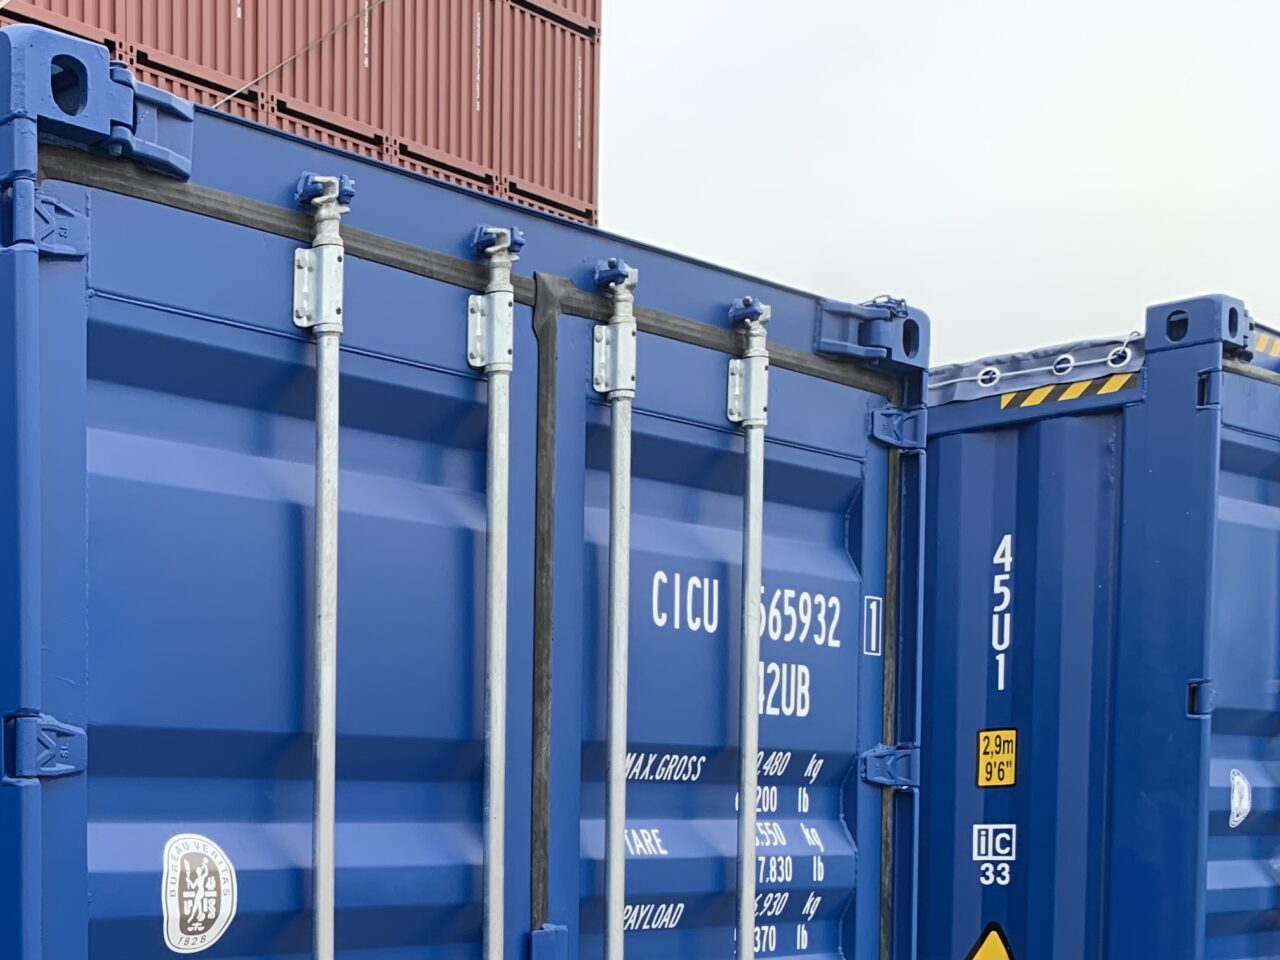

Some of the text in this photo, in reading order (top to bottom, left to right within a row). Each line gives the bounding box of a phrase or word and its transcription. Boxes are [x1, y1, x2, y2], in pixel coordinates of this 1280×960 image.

[652, 570, 719, 633] CICU
[992, 534, 1013, 690] 45U1
[982, 734, 1014, 759] 2,9m
[626, 752, 706, 782] MAX.GROSS
[804, 753, 824, 784] kg
[986, 761, 1012, 782] 9'6"
[798, 786, 810, 813] lb
[624, 829, 668, 856] TARE
[800, 822, 824, 853] kg
[169, 842, 230, 897] BUREAU VERITAS
[813, 856, 824, 882] lb
[980, 862, 1010, 886] 33
[624, 902, 684, 930] PAYLOAD
[802, 891, 822, 922] kg
[178, 935, 206, 946] 1828
[796, 924, 808, 950] lb
